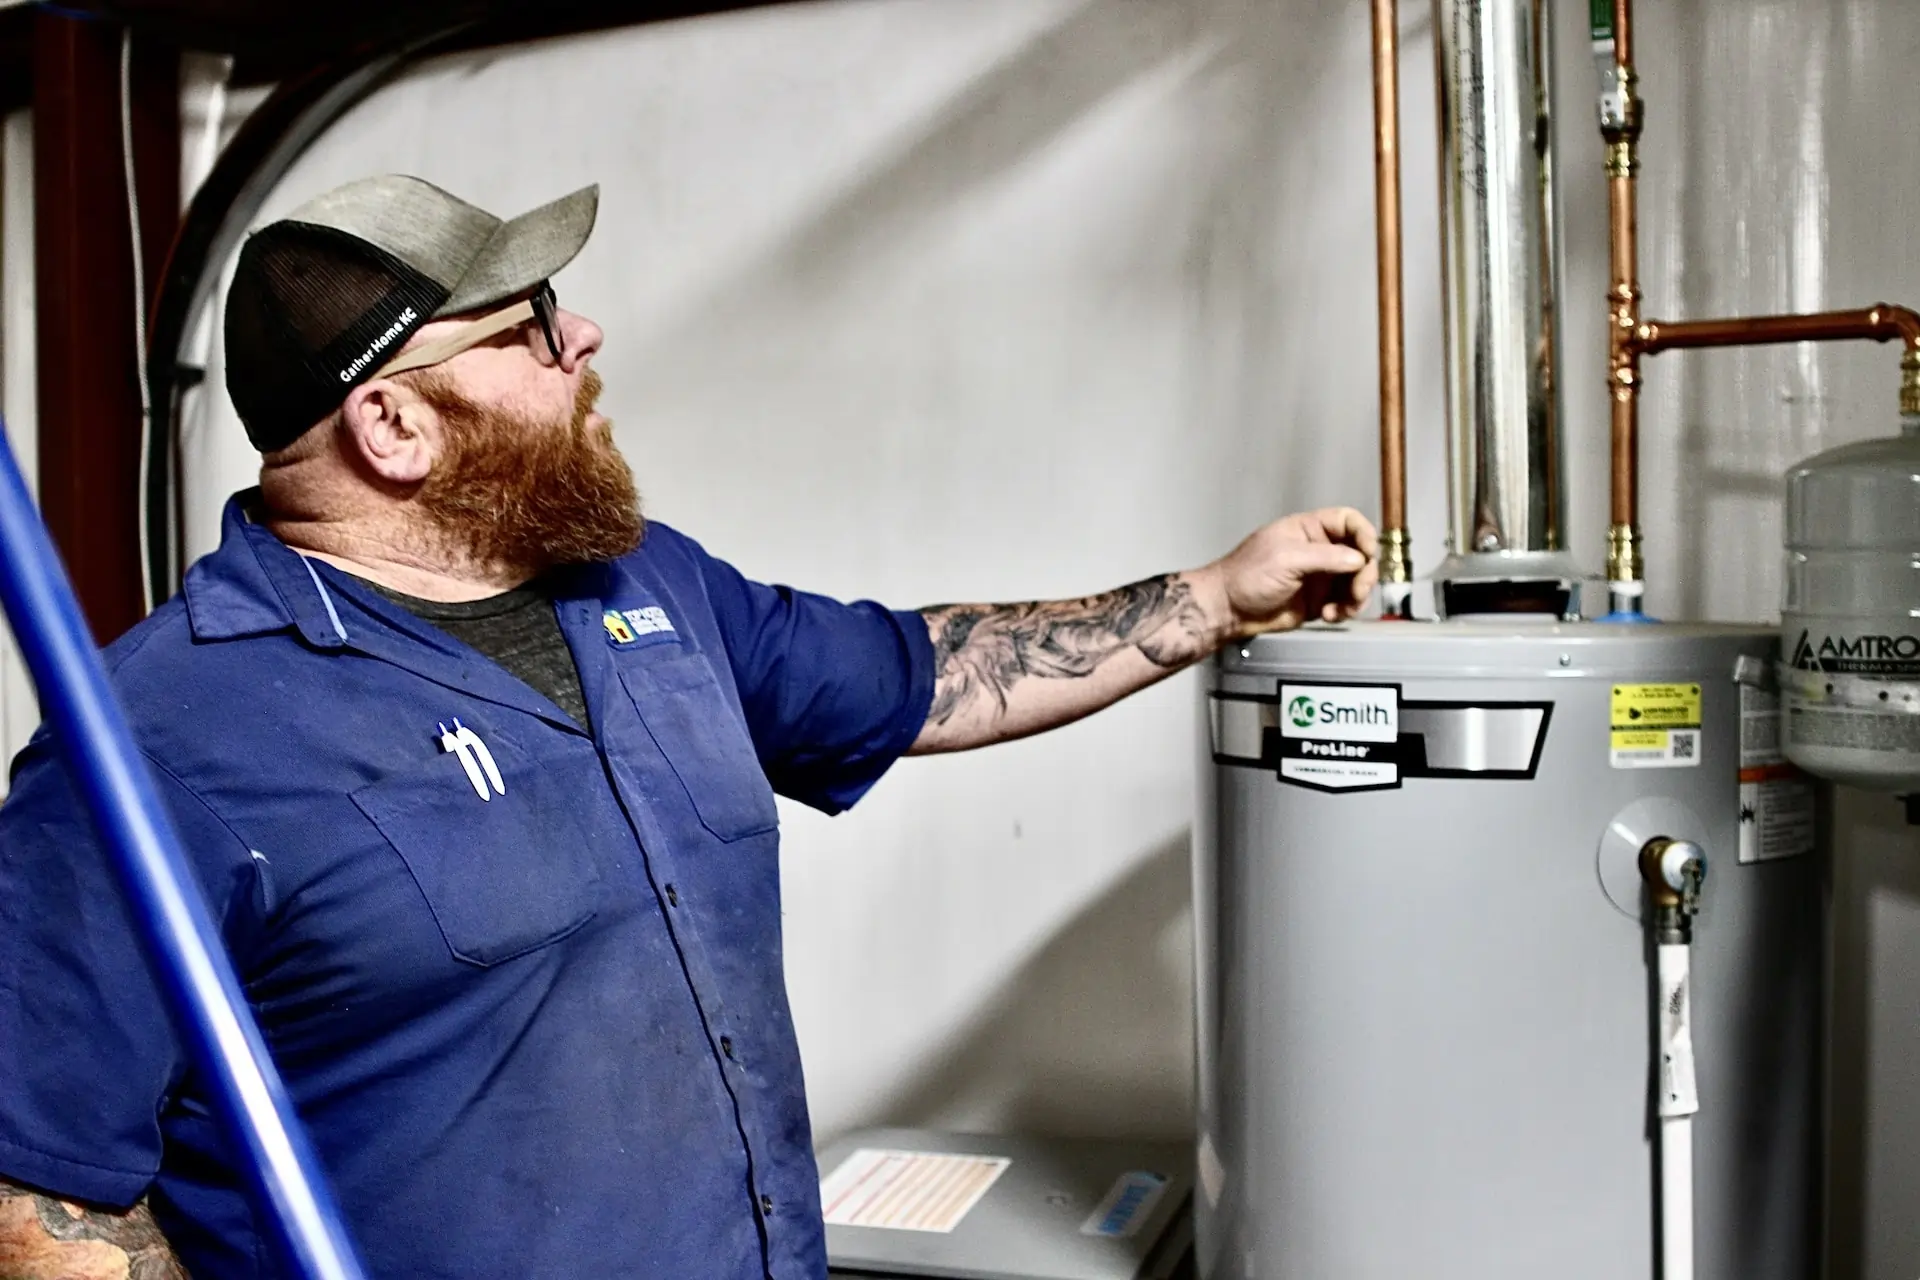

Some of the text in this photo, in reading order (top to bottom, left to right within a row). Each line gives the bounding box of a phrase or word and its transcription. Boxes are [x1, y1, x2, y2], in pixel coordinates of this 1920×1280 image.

[340, 306, 417, 382] Gather Home KC
[1320, 702, 1388, 724] Smith
[1301, 741, 1367, 758] ProLine
